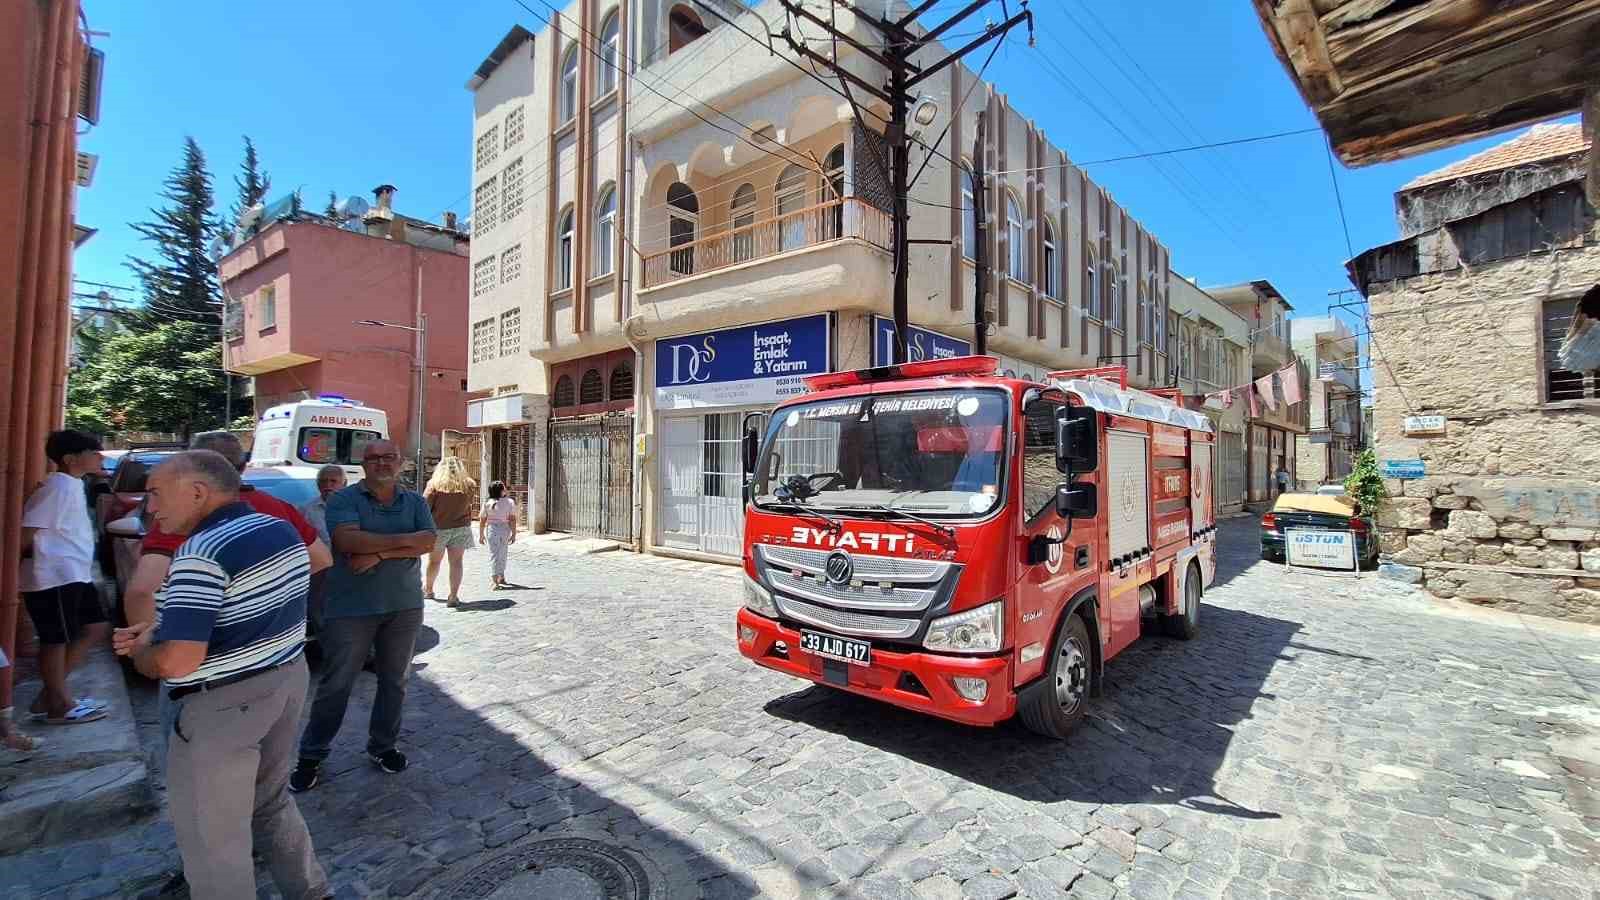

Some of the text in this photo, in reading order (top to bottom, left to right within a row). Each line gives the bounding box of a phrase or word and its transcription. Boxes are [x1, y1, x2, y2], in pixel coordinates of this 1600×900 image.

[754, 331, 791, 346] İnşaat,
[754, 345, 789, 360] Emlak
[754, 359, 807, 374] & Yatırım
[818, 404, 848, 416] MERSİN
[901, 396, 956, 410] BELEDİYESİ
[310, 415, 373, 427] AMBULANS
[1295, 533, 1344, 544] ÜSTÜN
[808, 634, 867, 660] 33 AJD 617
